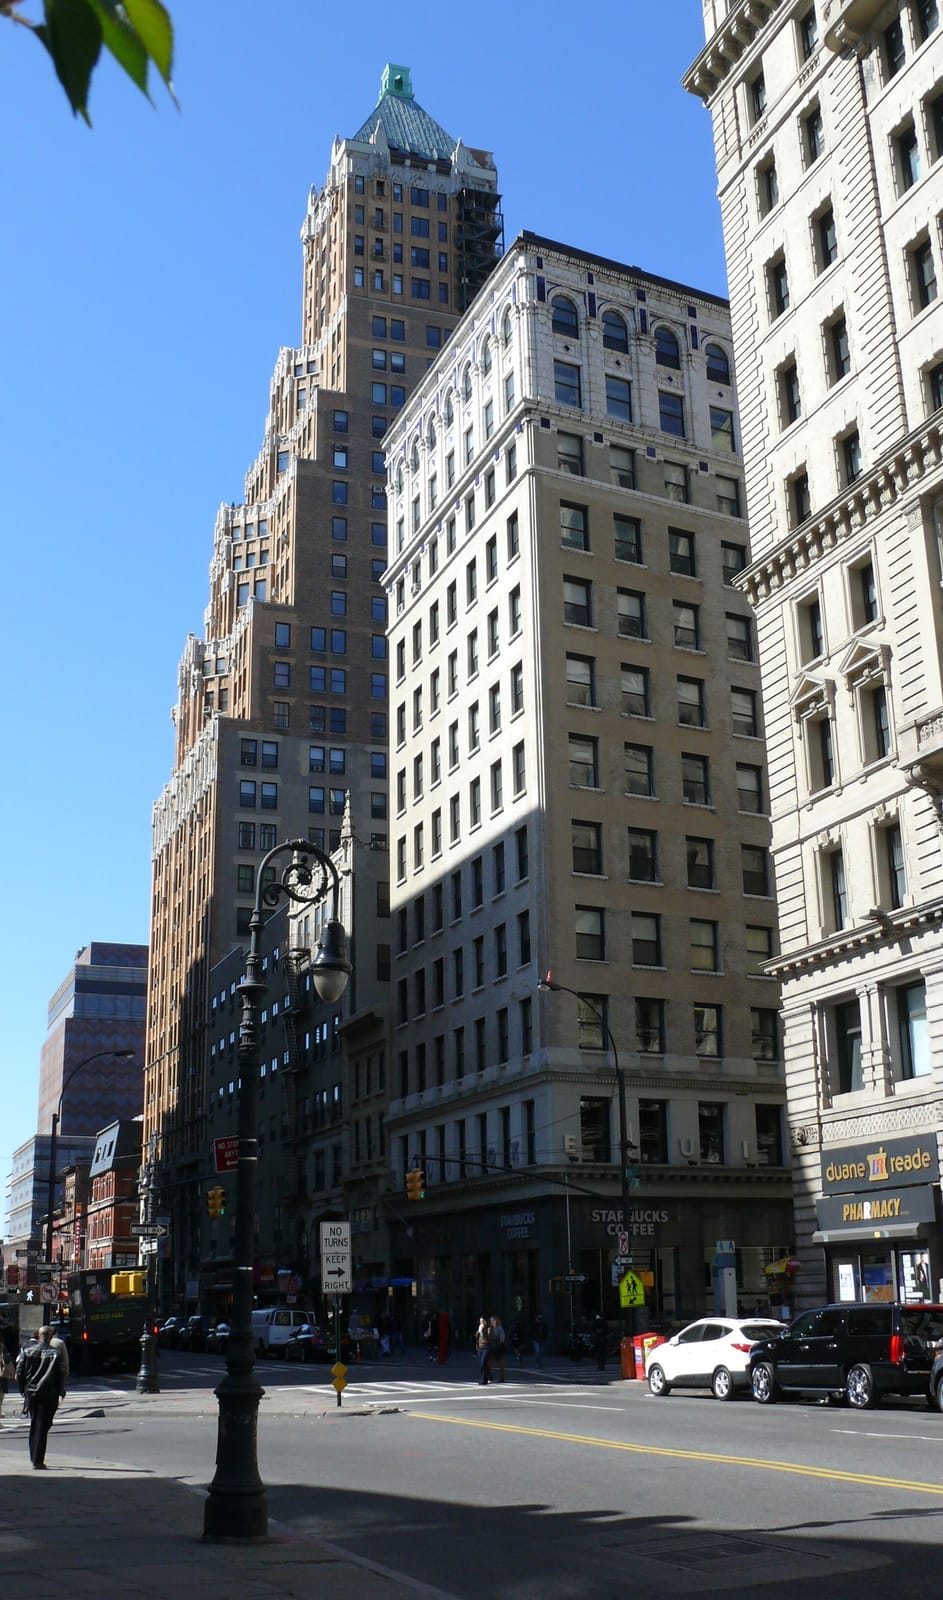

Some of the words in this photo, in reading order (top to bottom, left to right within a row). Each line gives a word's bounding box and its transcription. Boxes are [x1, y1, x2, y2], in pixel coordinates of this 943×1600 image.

[218, 1142, 226, 1150] NO
[826, 1161, 866, 1182] duane
[890, 1147, 931, 1171] reade
[843, 1198, 900, 1222] PHARMACY
[329, 1227, 342, 1236] NO
[607, 1223, 655, 1236] COFEE
[324, 1238, 348, 1247] TURNS
[326, 1255, 347, 1264] KEEP
[325, 1281, 348, 1289] RIGHT
